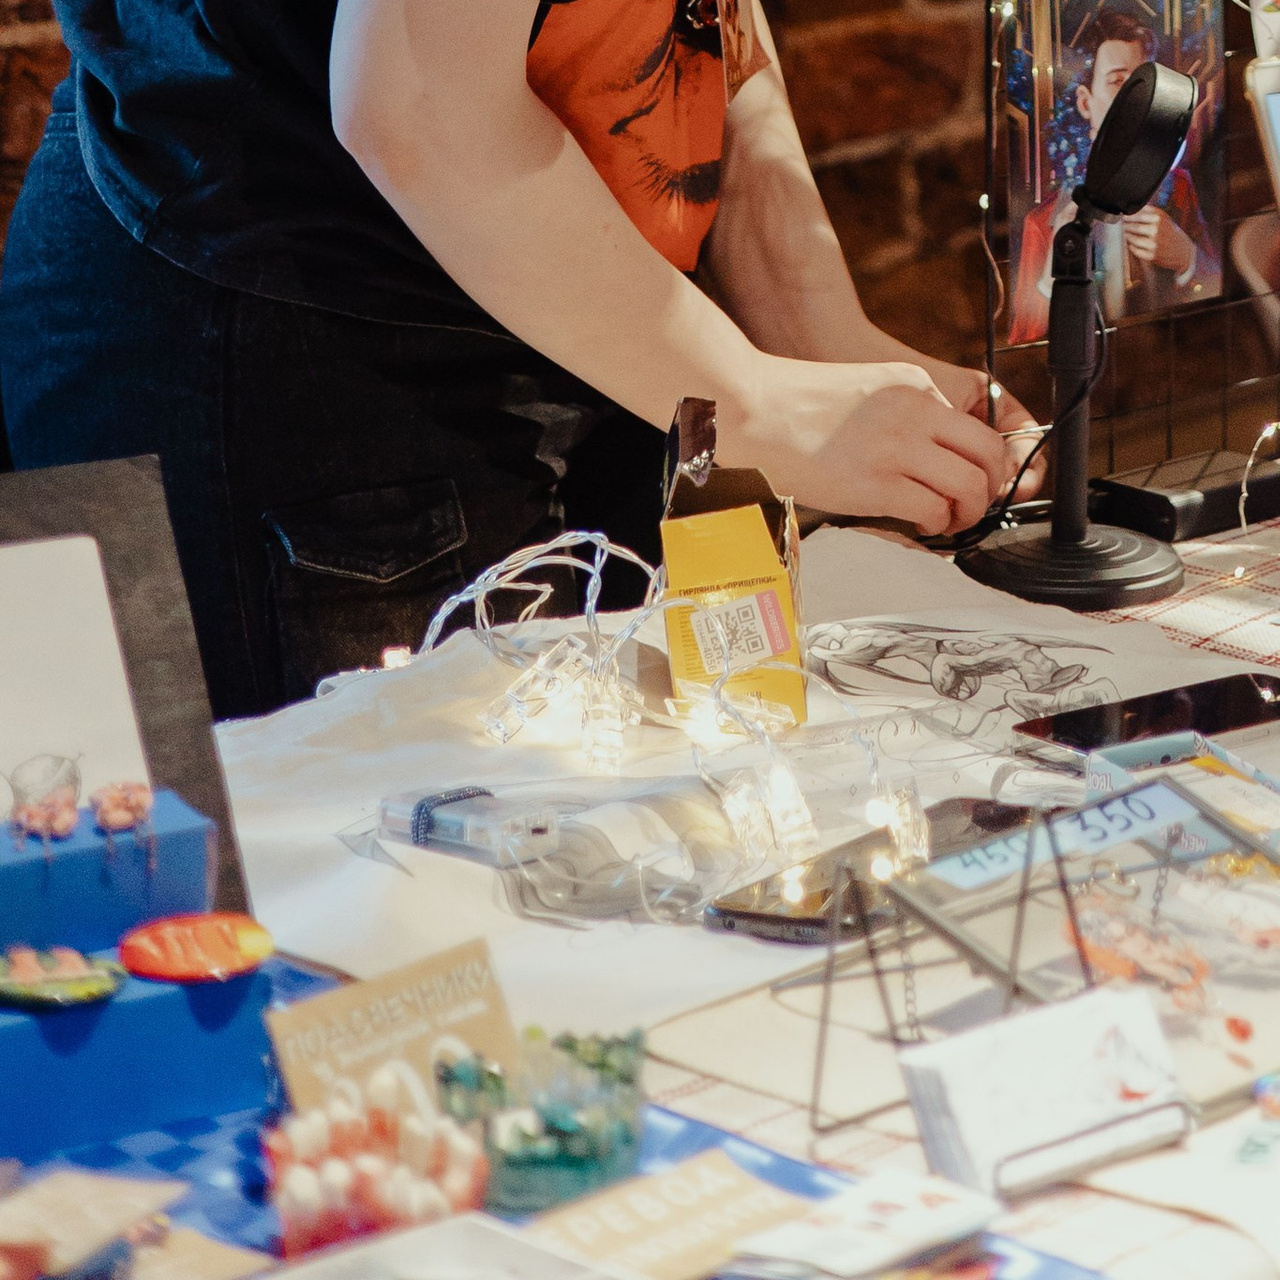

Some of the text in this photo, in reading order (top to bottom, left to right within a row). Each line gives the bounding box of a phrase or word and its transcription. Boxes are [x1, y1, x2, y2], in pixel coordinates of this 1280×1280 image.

[678, 584, 720, 597] ГИРЛЯНДА
[762, 593, 786, 651] WILDBERRIES
[1069, 796, 1156, 841] 350
